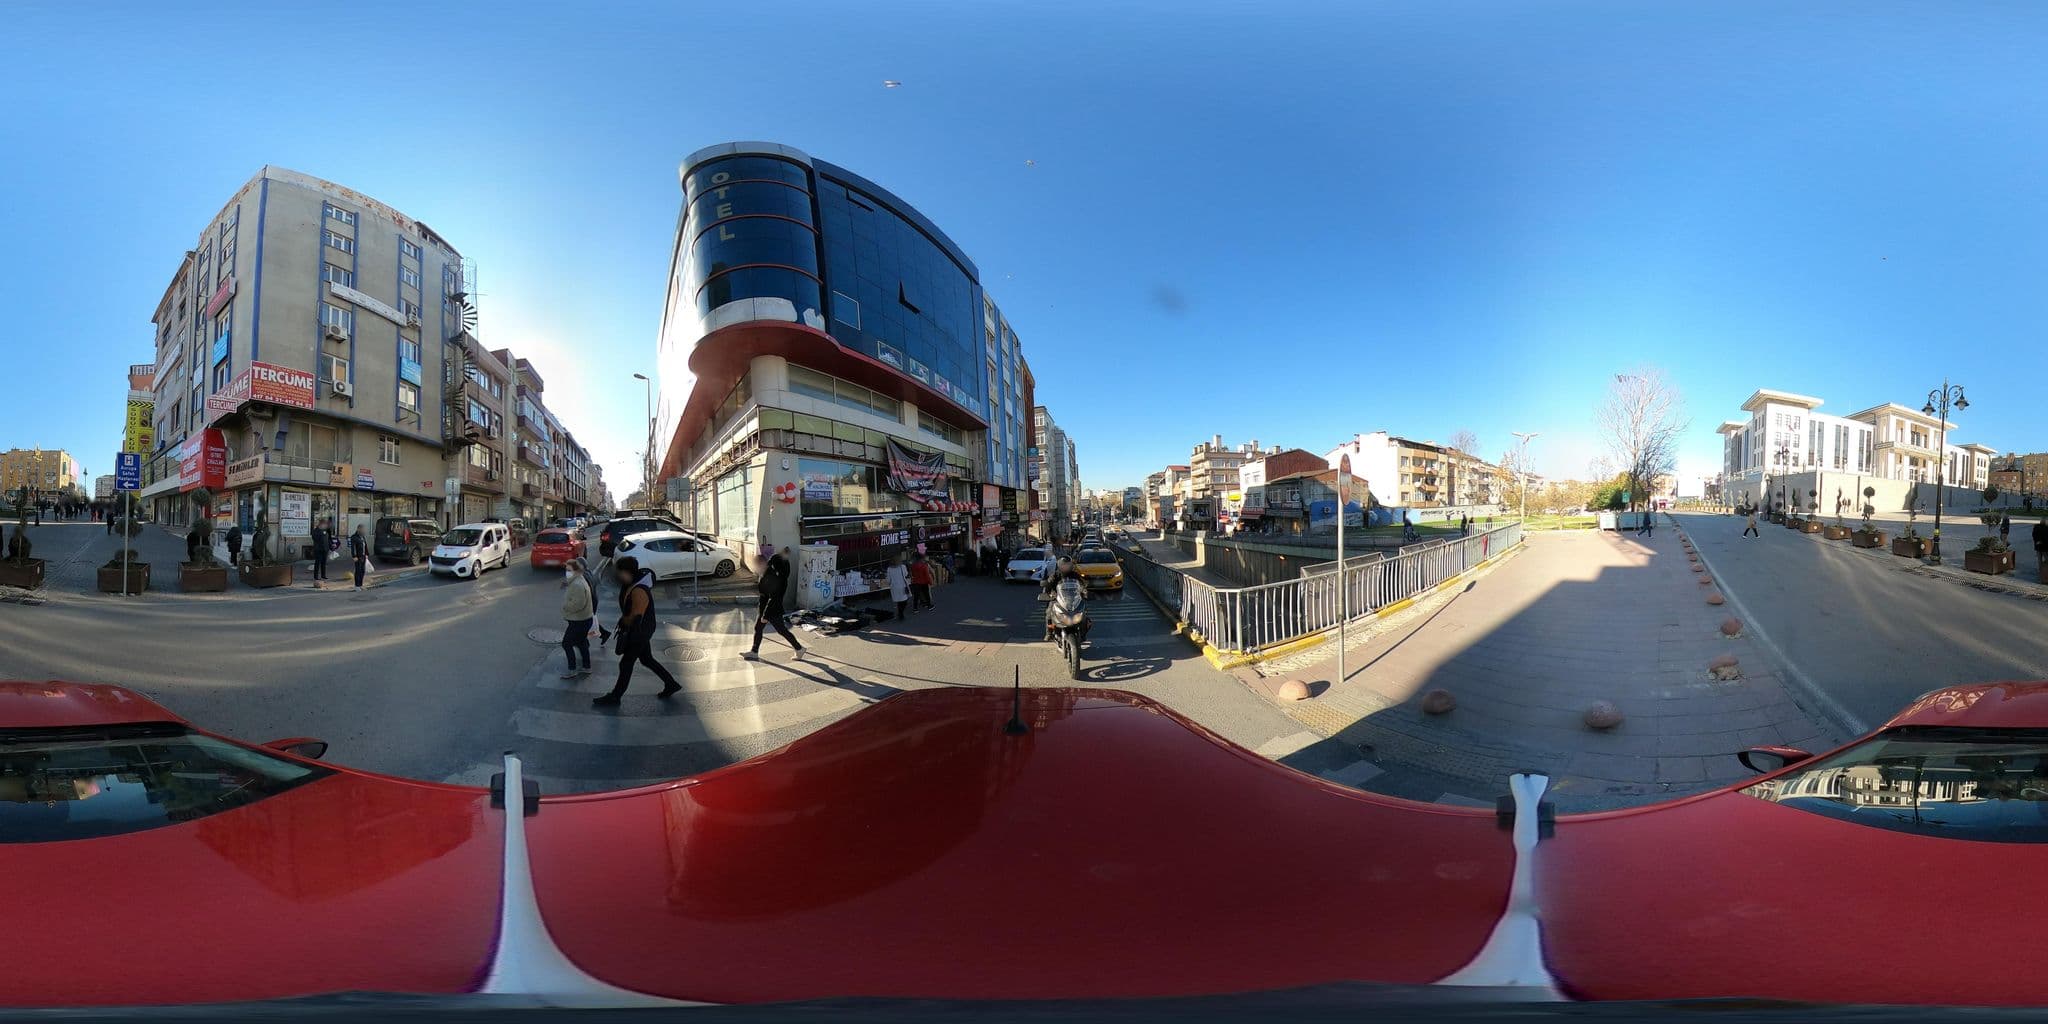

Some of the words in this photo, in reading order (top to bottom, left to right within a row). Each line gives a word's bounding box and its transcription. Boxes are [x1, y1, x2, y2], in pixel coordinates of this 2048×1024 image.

[711, 172, 735, 241] OTEL
[252, 366, 313, 390] TERCÜME
[880, 533, 899, 546] HOME
